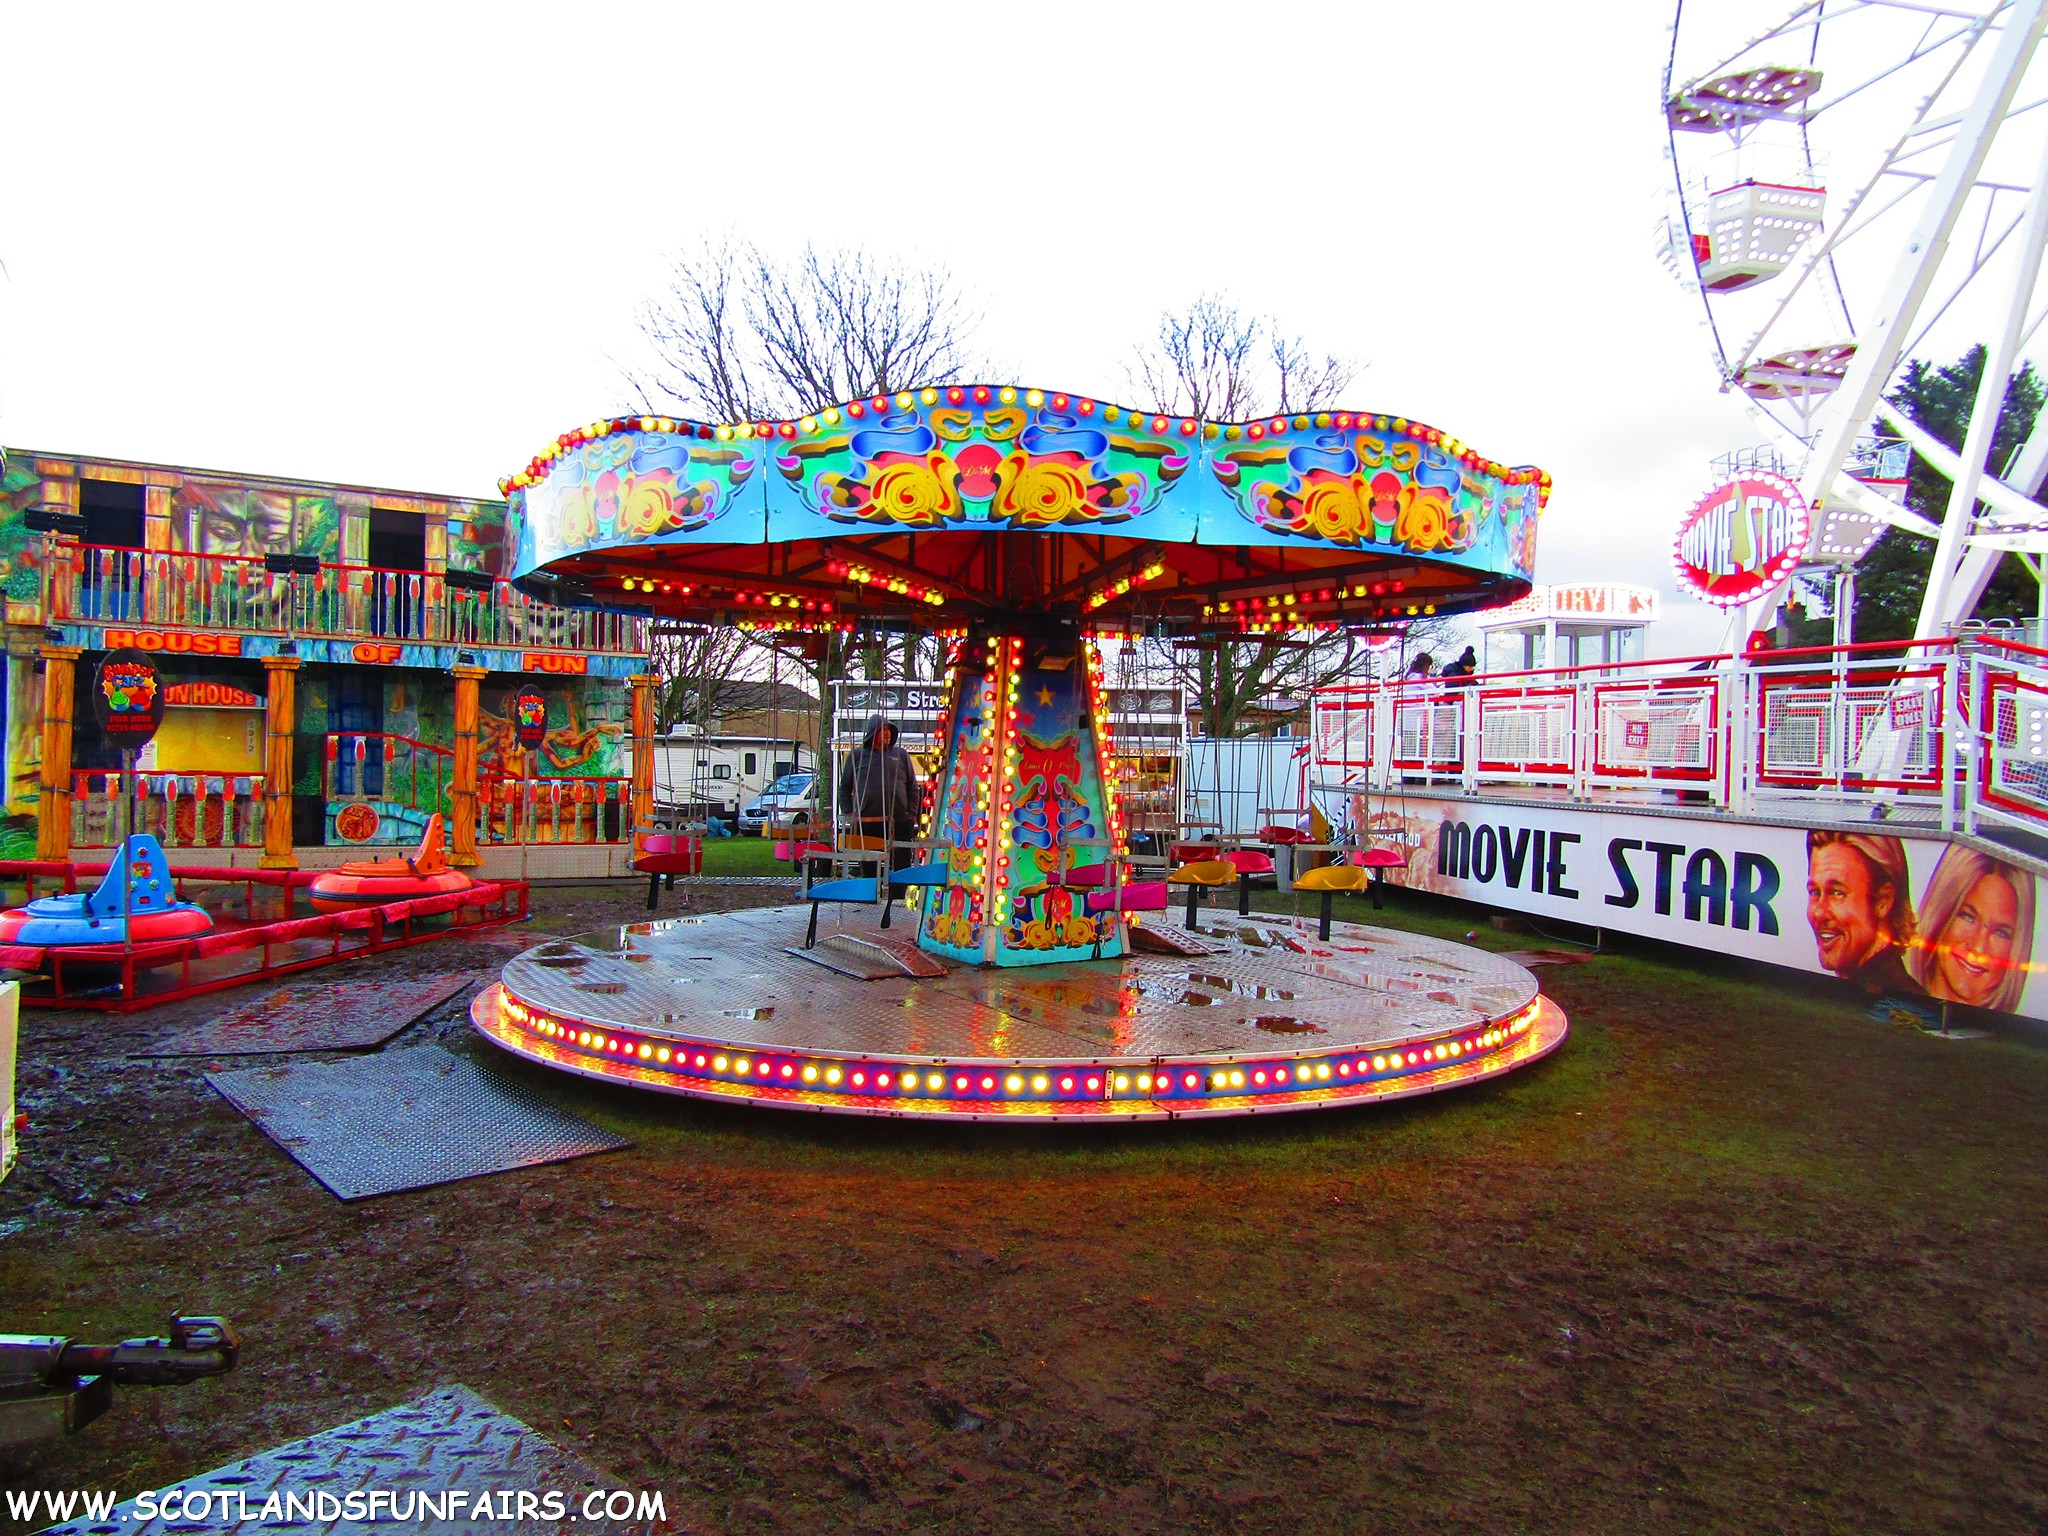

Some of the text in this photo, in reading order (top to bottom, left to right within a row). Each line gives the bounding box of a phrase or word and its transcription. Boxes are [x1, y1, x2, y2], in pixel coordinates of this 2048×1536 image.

[1680, 495, 1797, 576] MOVIE STAR
[104, 629, 588, 675] HOUSE OF FUN
[164, 682, 255, 705] UN HOUSE
[907, 690, 947, 708] Stre
[1437, 819, 1781, 937] MOVIE STAR
